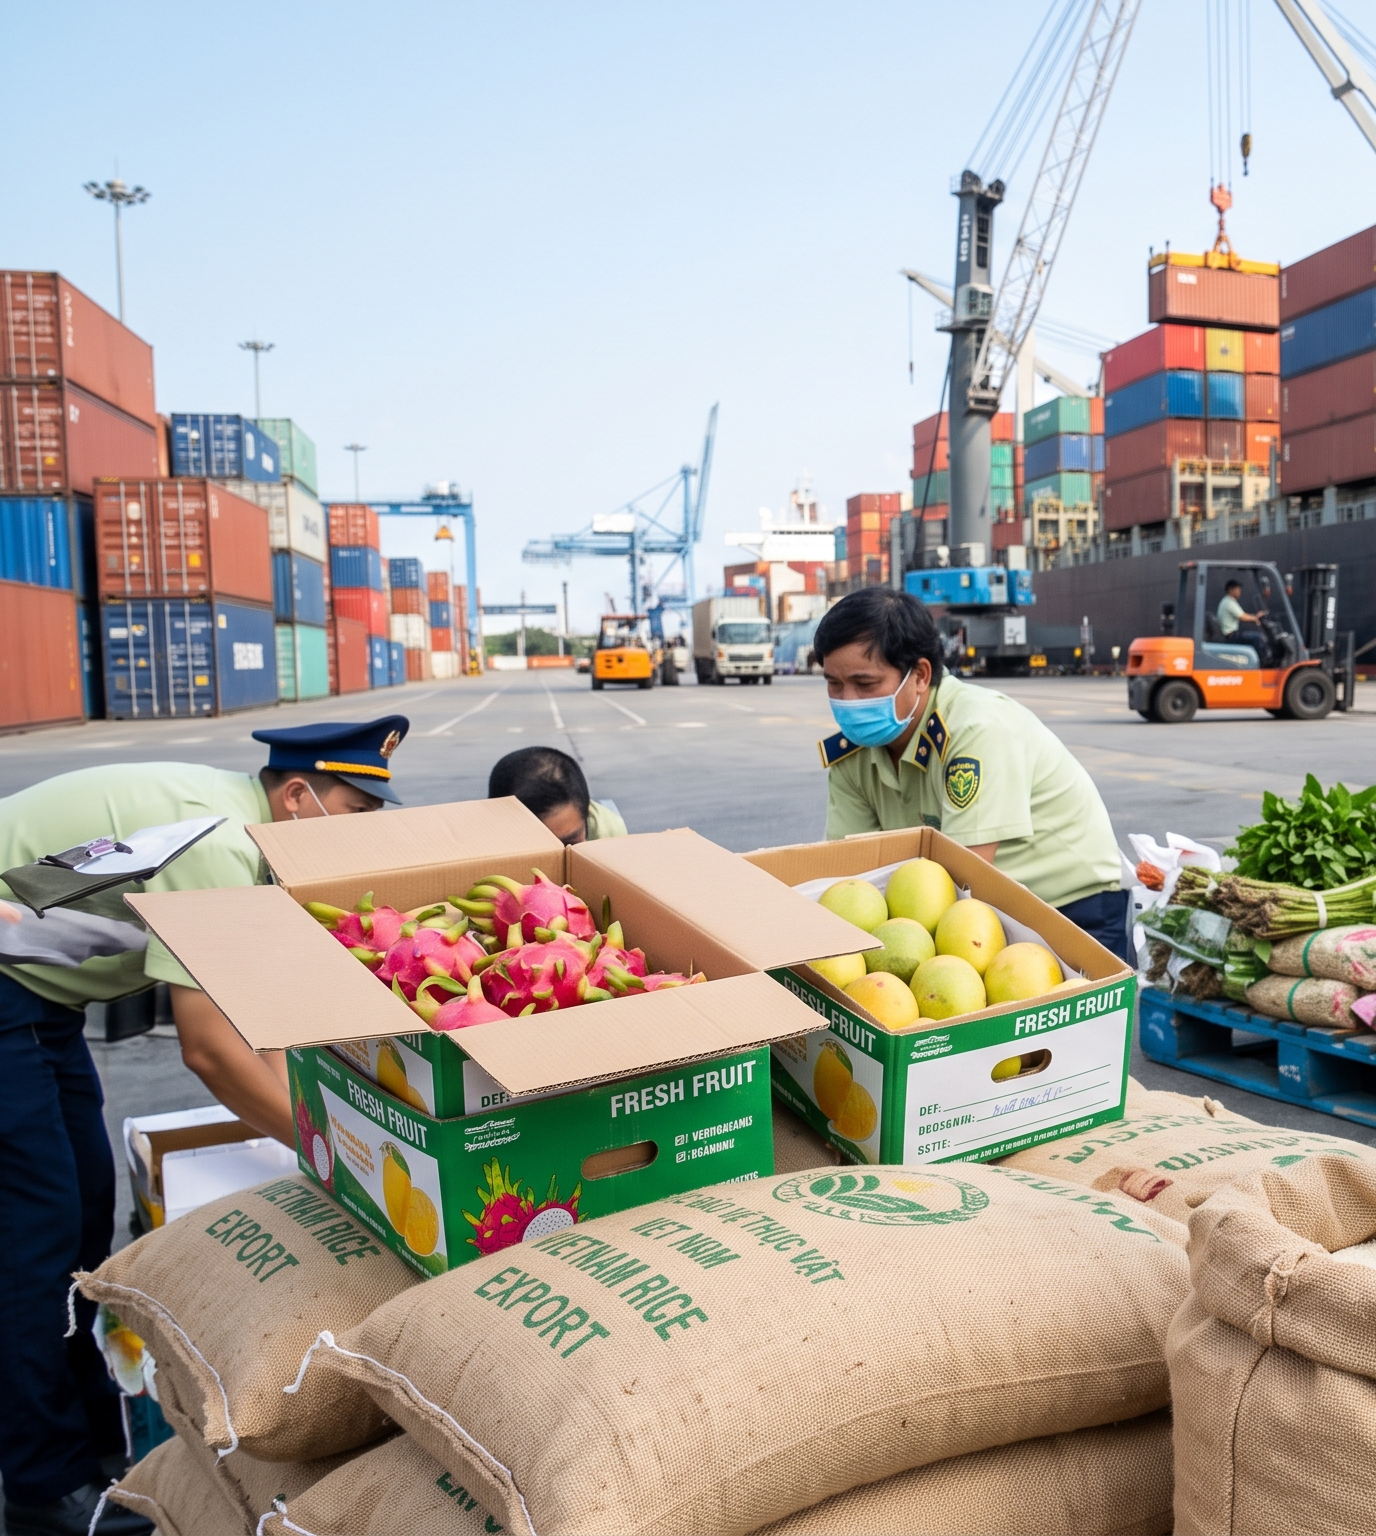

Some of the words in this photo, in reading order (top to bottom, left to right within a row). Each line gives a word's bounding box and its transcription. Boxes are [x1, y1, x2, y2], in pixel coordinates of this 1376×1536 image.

[831, 1008, 877, 1053] FRUIT
[1014, 1006, 1071, 1036] FRESH
[1075, 987, 1126, 1019] FRUIT
[347, 1078, 386, 1125] FRESH
[387, 1105, 427, 1149] FRUIT
[610, 1078, 684, 1119] FRESH
[692, 1060, 757, 1098] FRUIT
[919, 1103, 942, 1117] DEF:
[204, 1209, 300, 1283] EXPORT
[253, 1179, 342, 1229] VIETNAM
[311, 1220, 381, 1266] RICE
[473, 1266, 611, 1359] EXPORT
[530, 1232, 651, 1288] VIETNAM
[619, 1273, 709, 1342] RICE
